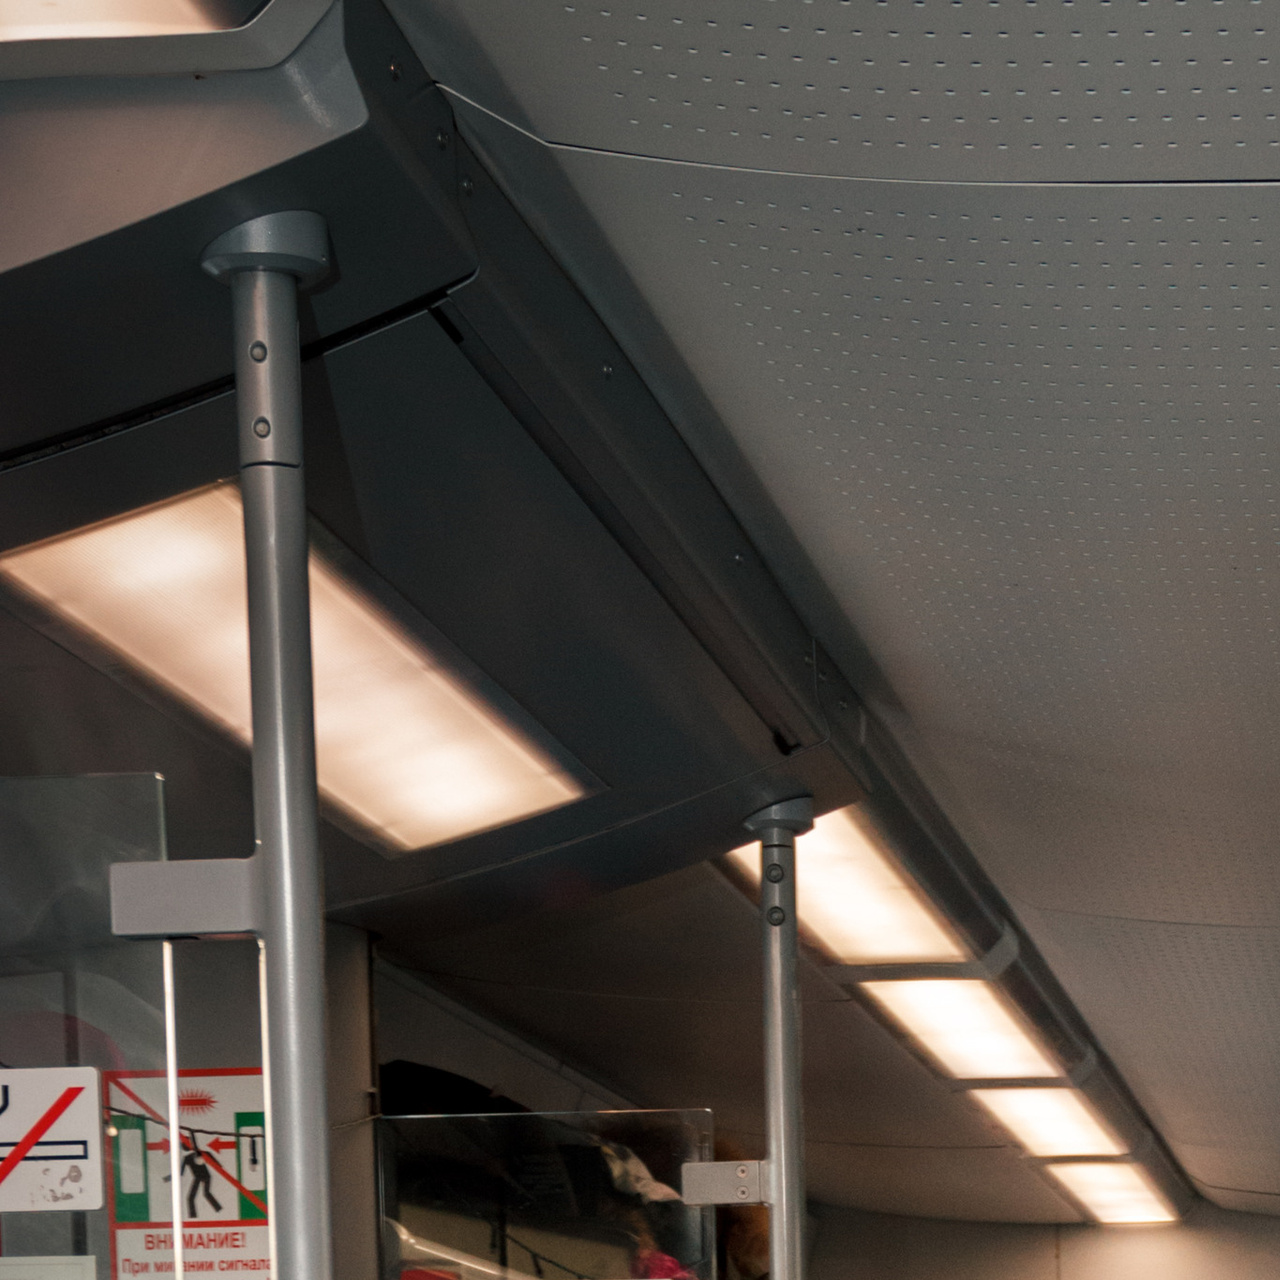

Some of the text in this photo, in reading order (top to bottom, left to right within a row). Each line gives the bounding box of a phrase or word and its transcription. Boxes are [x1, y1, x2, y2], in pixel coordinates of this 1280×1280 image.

[144, 1232, 246, 1250] ВНМАНИЕ!
[122, 1258, 149, 1276] При
[154, 1259, 215, 1273] миании
